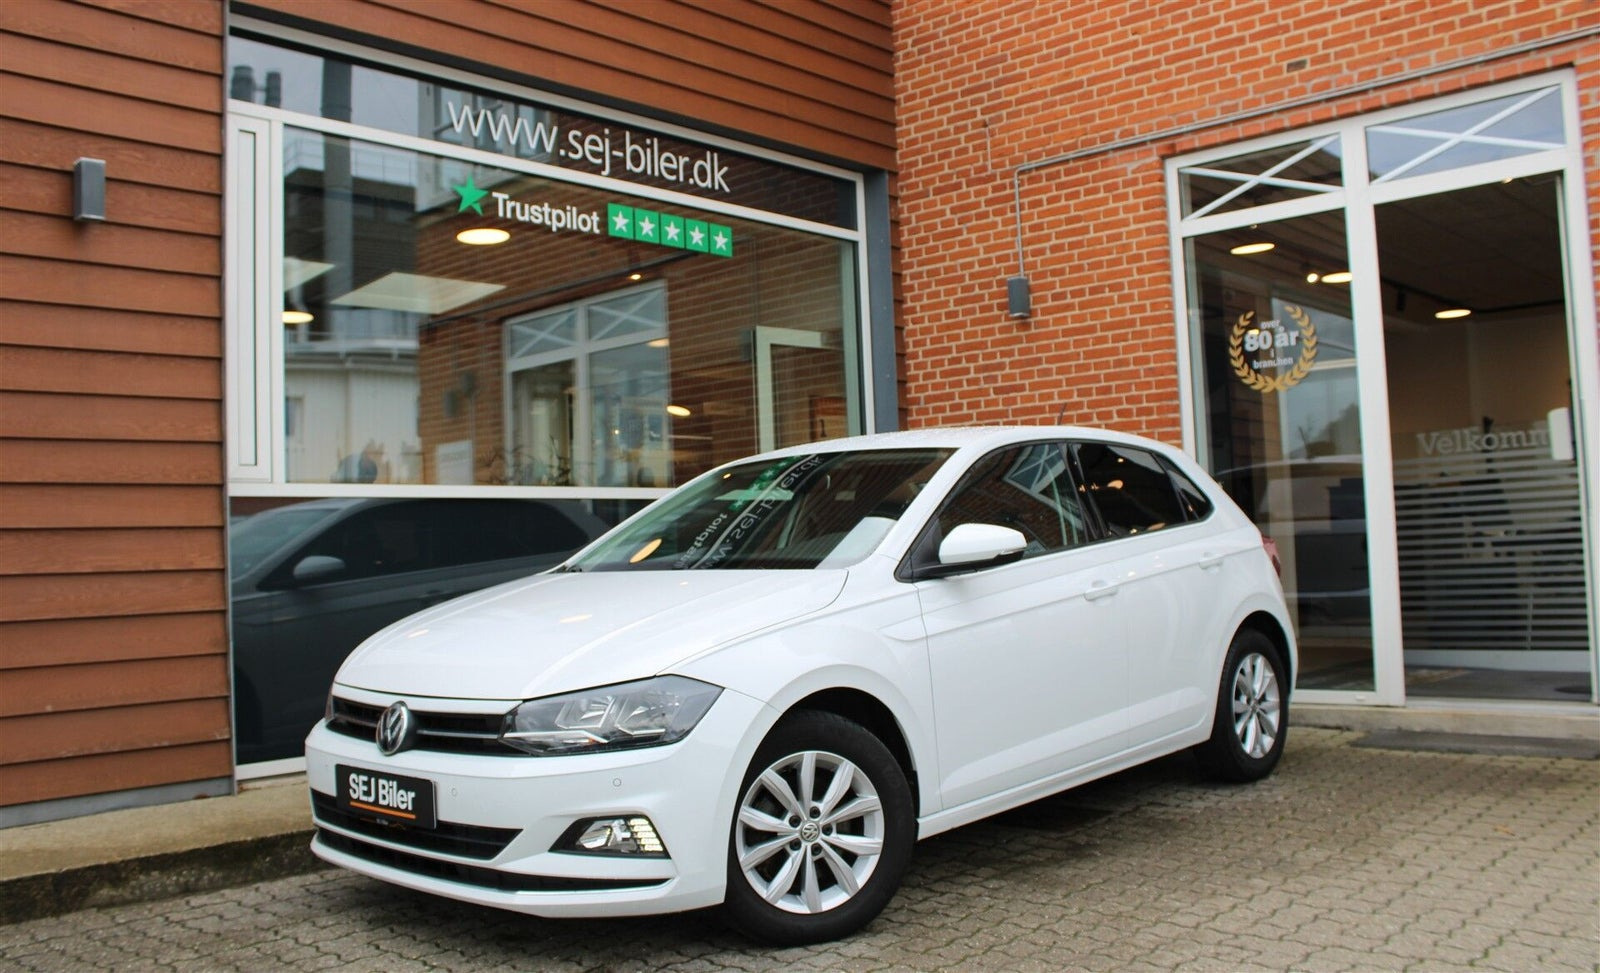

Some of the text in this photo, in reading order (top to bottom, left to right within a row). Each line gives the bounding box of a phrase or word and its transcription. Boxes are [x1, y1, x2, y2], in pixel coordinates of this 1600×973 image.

[448, 101, 730, 192] www.sej-biler.dk
[492, 192, 600, 234] Trustpilot
[1244, 325, 1299, 352] 80 år
[1260, 320, 1280, 330] over
[349, 773, 415, 811] SEJ Biler
